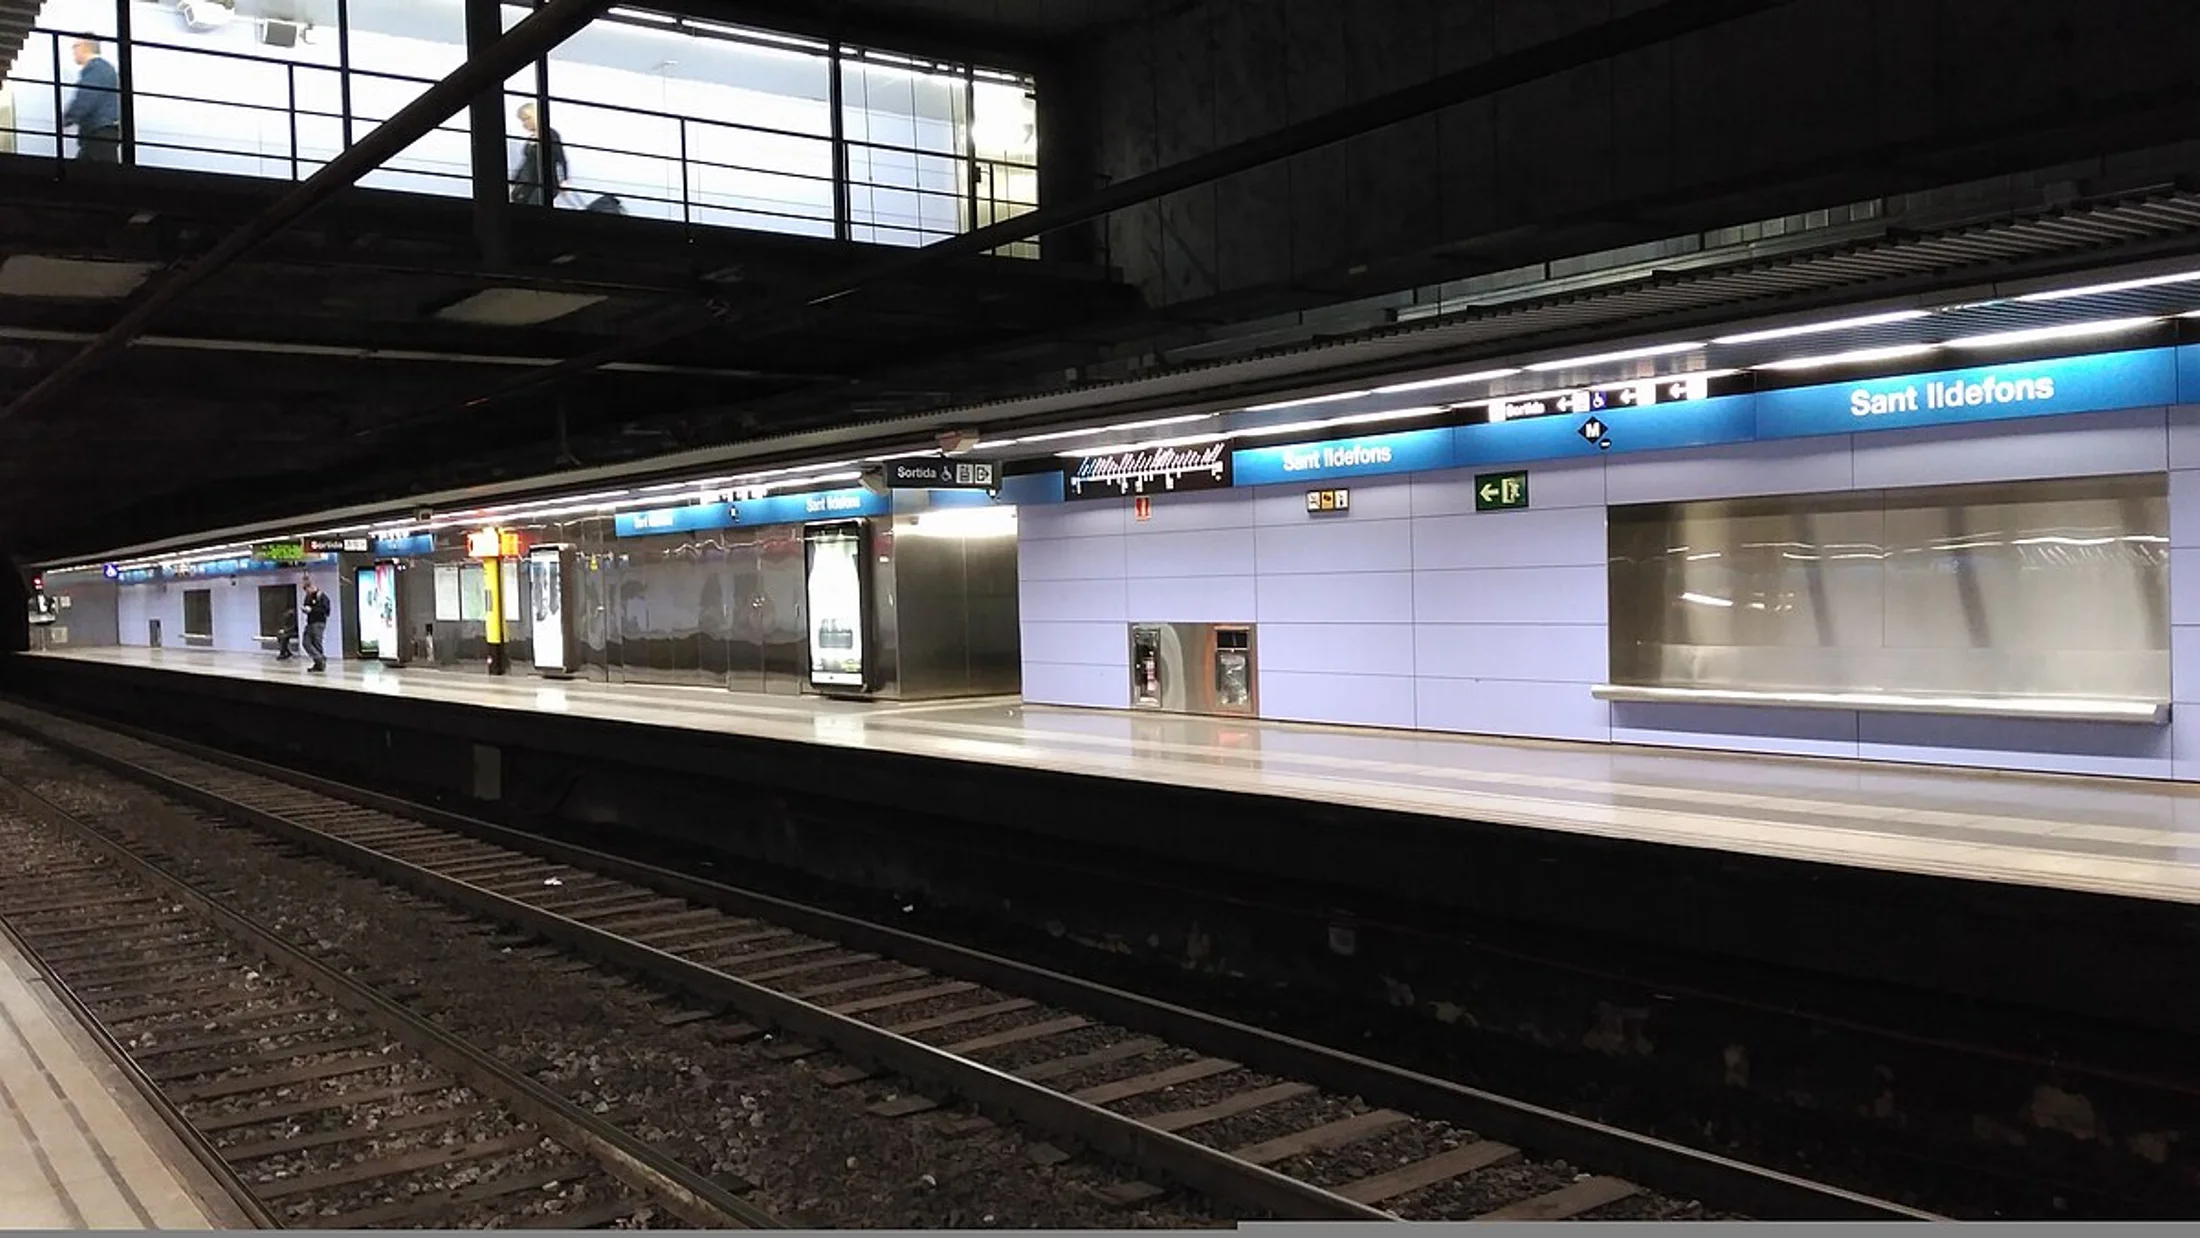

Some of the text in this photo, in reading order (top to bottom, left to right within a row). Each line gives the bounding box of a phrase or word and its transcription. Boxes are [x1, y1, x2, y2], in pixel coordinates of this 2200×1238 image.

[1850, 375, 2055, 416] Sant Ildefons
[1585, 421, 1600, 438] M
[1283, 445, 1392, 471] Sant Ildefons
[897, 465, 937, 478] Sortida
